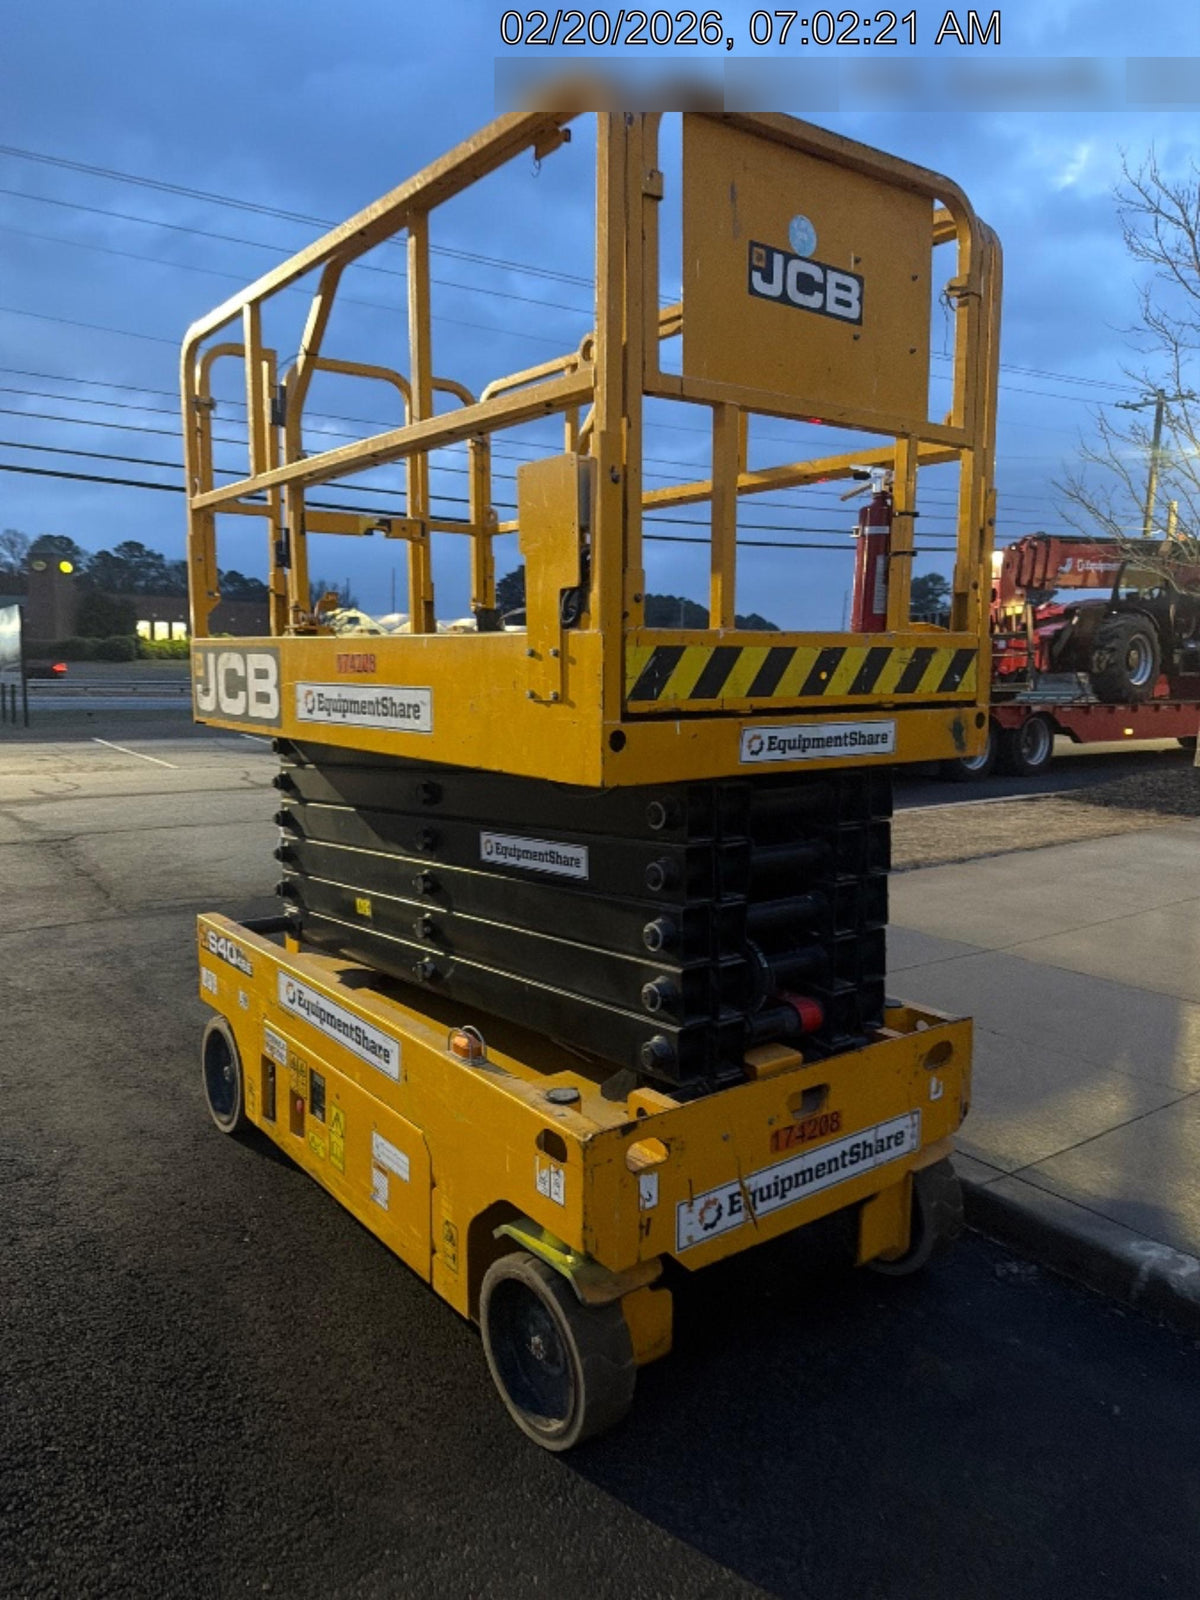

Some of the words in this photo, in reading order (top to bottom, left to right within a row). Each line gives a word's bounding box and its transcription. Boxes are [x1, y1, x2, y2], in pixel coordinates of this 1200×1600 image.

[752, 252, 861, 320] JCB
[196, 652, 280, 719] JCB
[317, 692, 422, 721] EquipmentShare
[767, 730, 888, 754] EquipmentShare
[495, 842, 582, 868] EquipmentShare
[297, 988, 391, 1065] EquipmentShare
[771, 1110, 841, 1151] 174208
